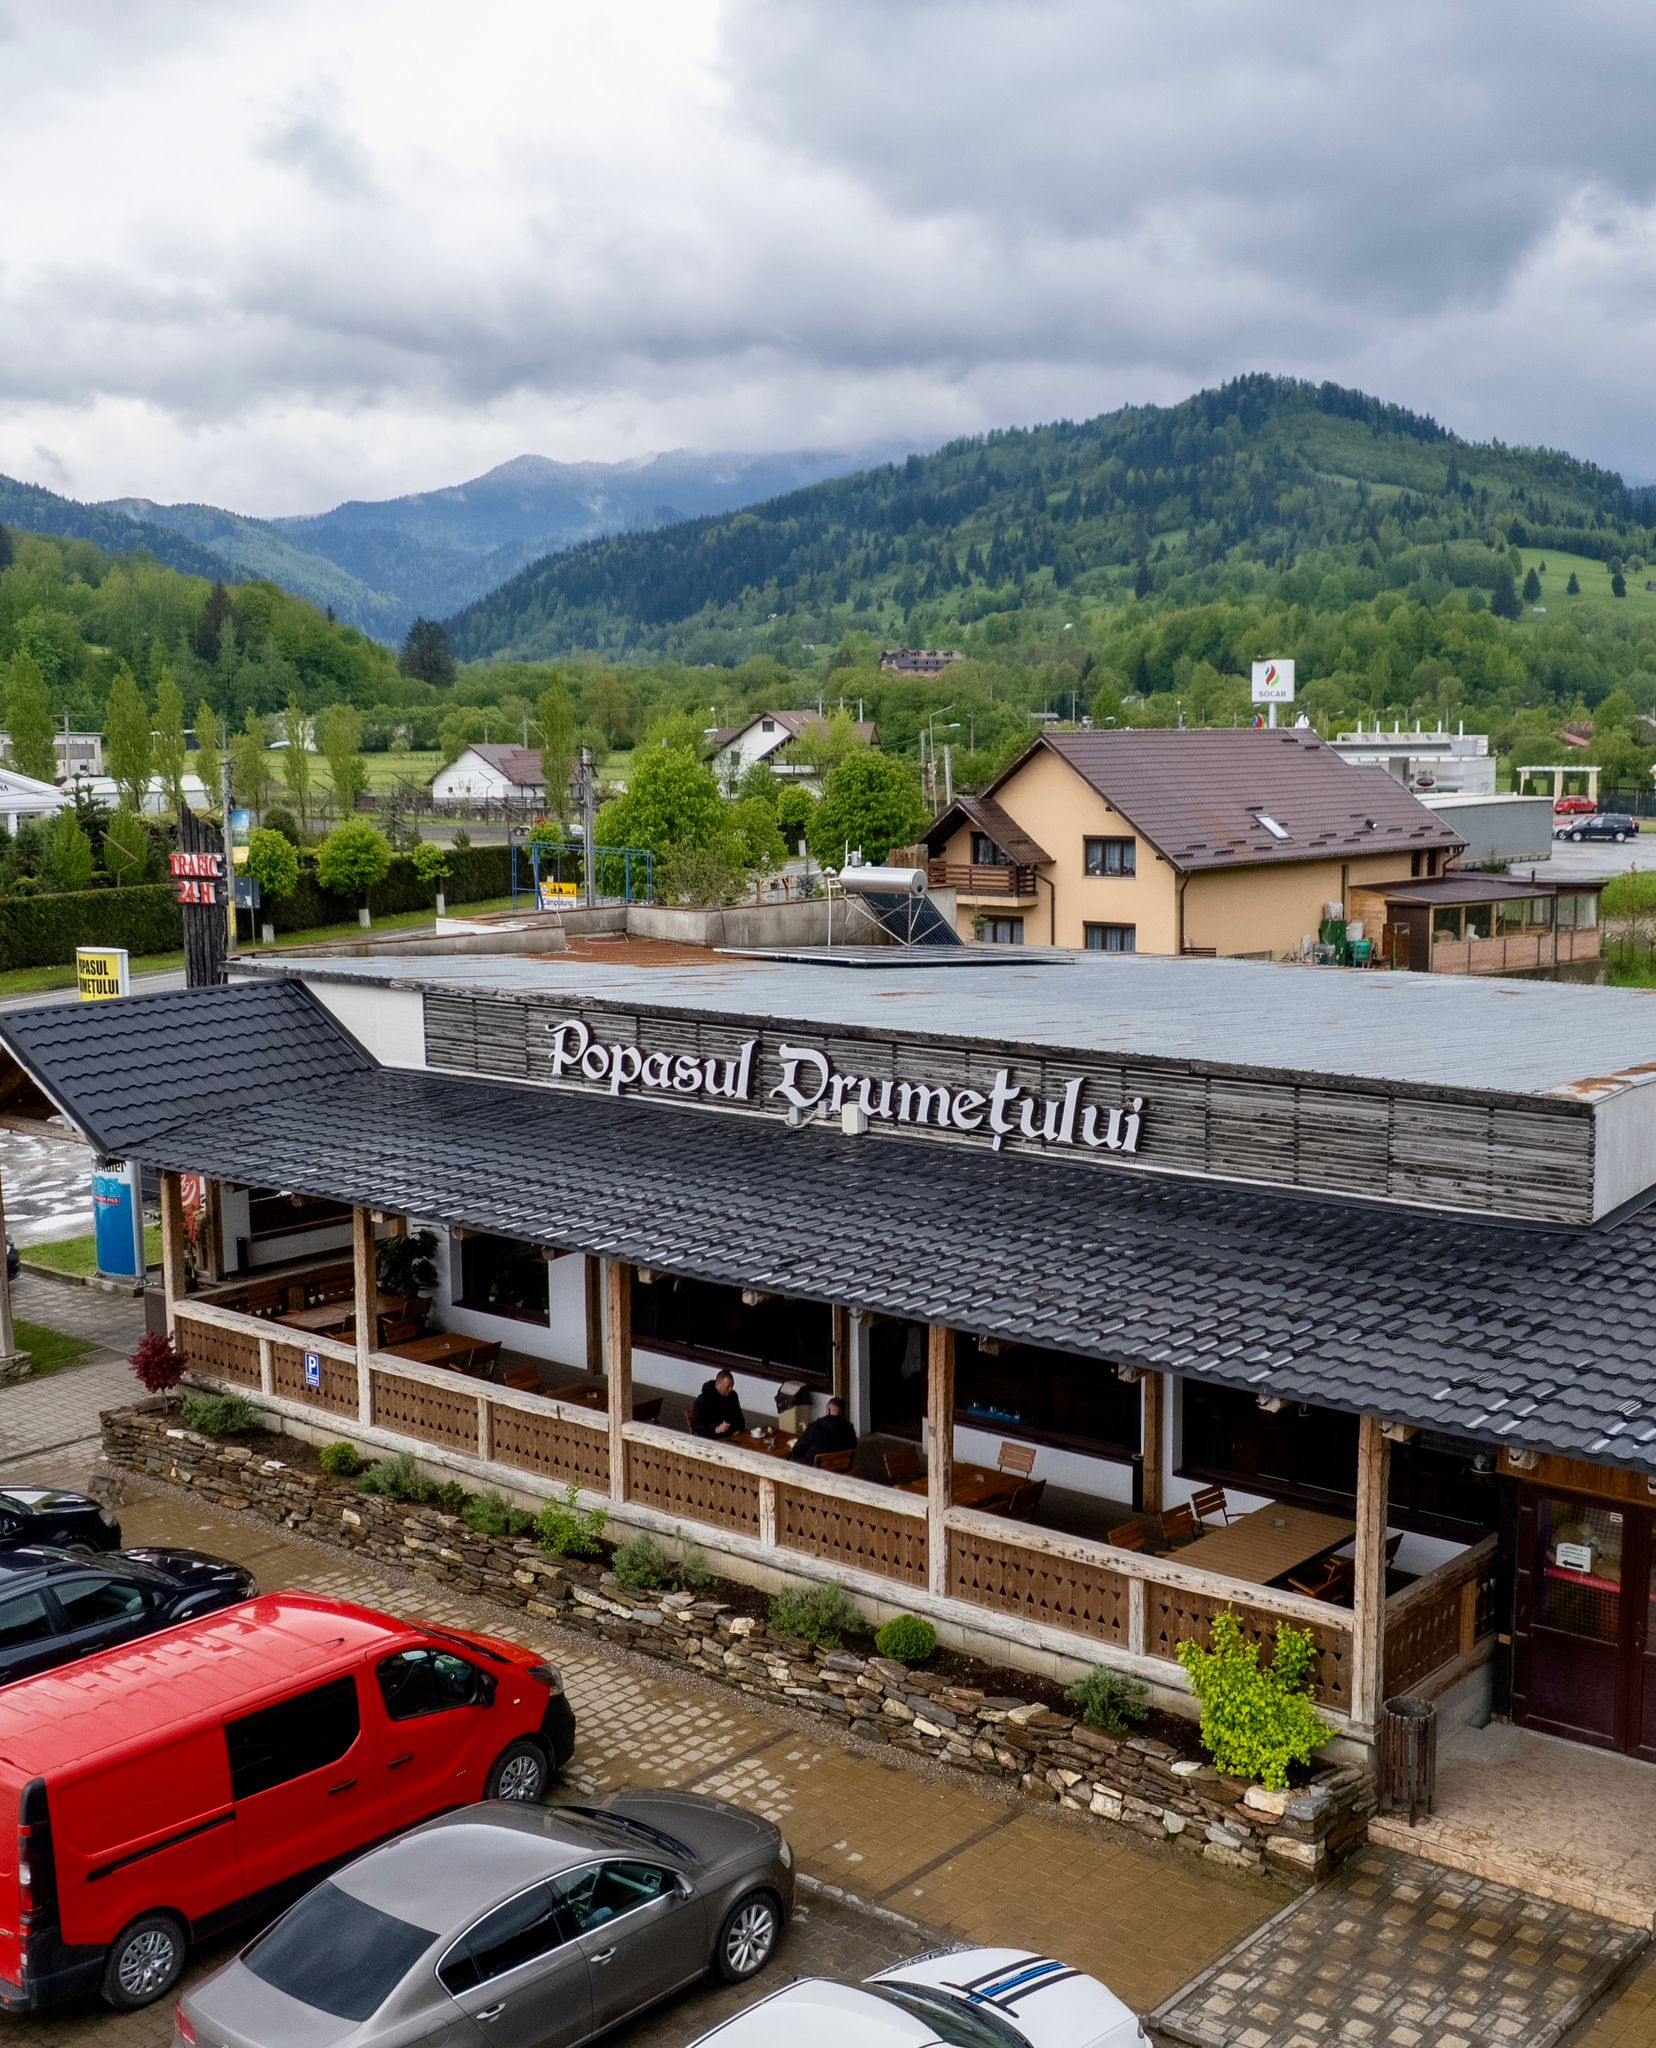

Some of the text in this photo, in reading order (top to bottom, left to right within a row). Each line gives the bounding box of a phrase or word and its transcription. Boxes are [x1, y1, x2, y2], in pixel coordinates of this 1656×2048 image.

[1258, 690, 1287, 698] SOCAR
[169, 853, 222, 877] TRAFIC
[178, 880, 216, 903] 24 H
[545, 1019, 1144, 1152] Popasul Drumețului
[308, 1355, 316, 1374] P
